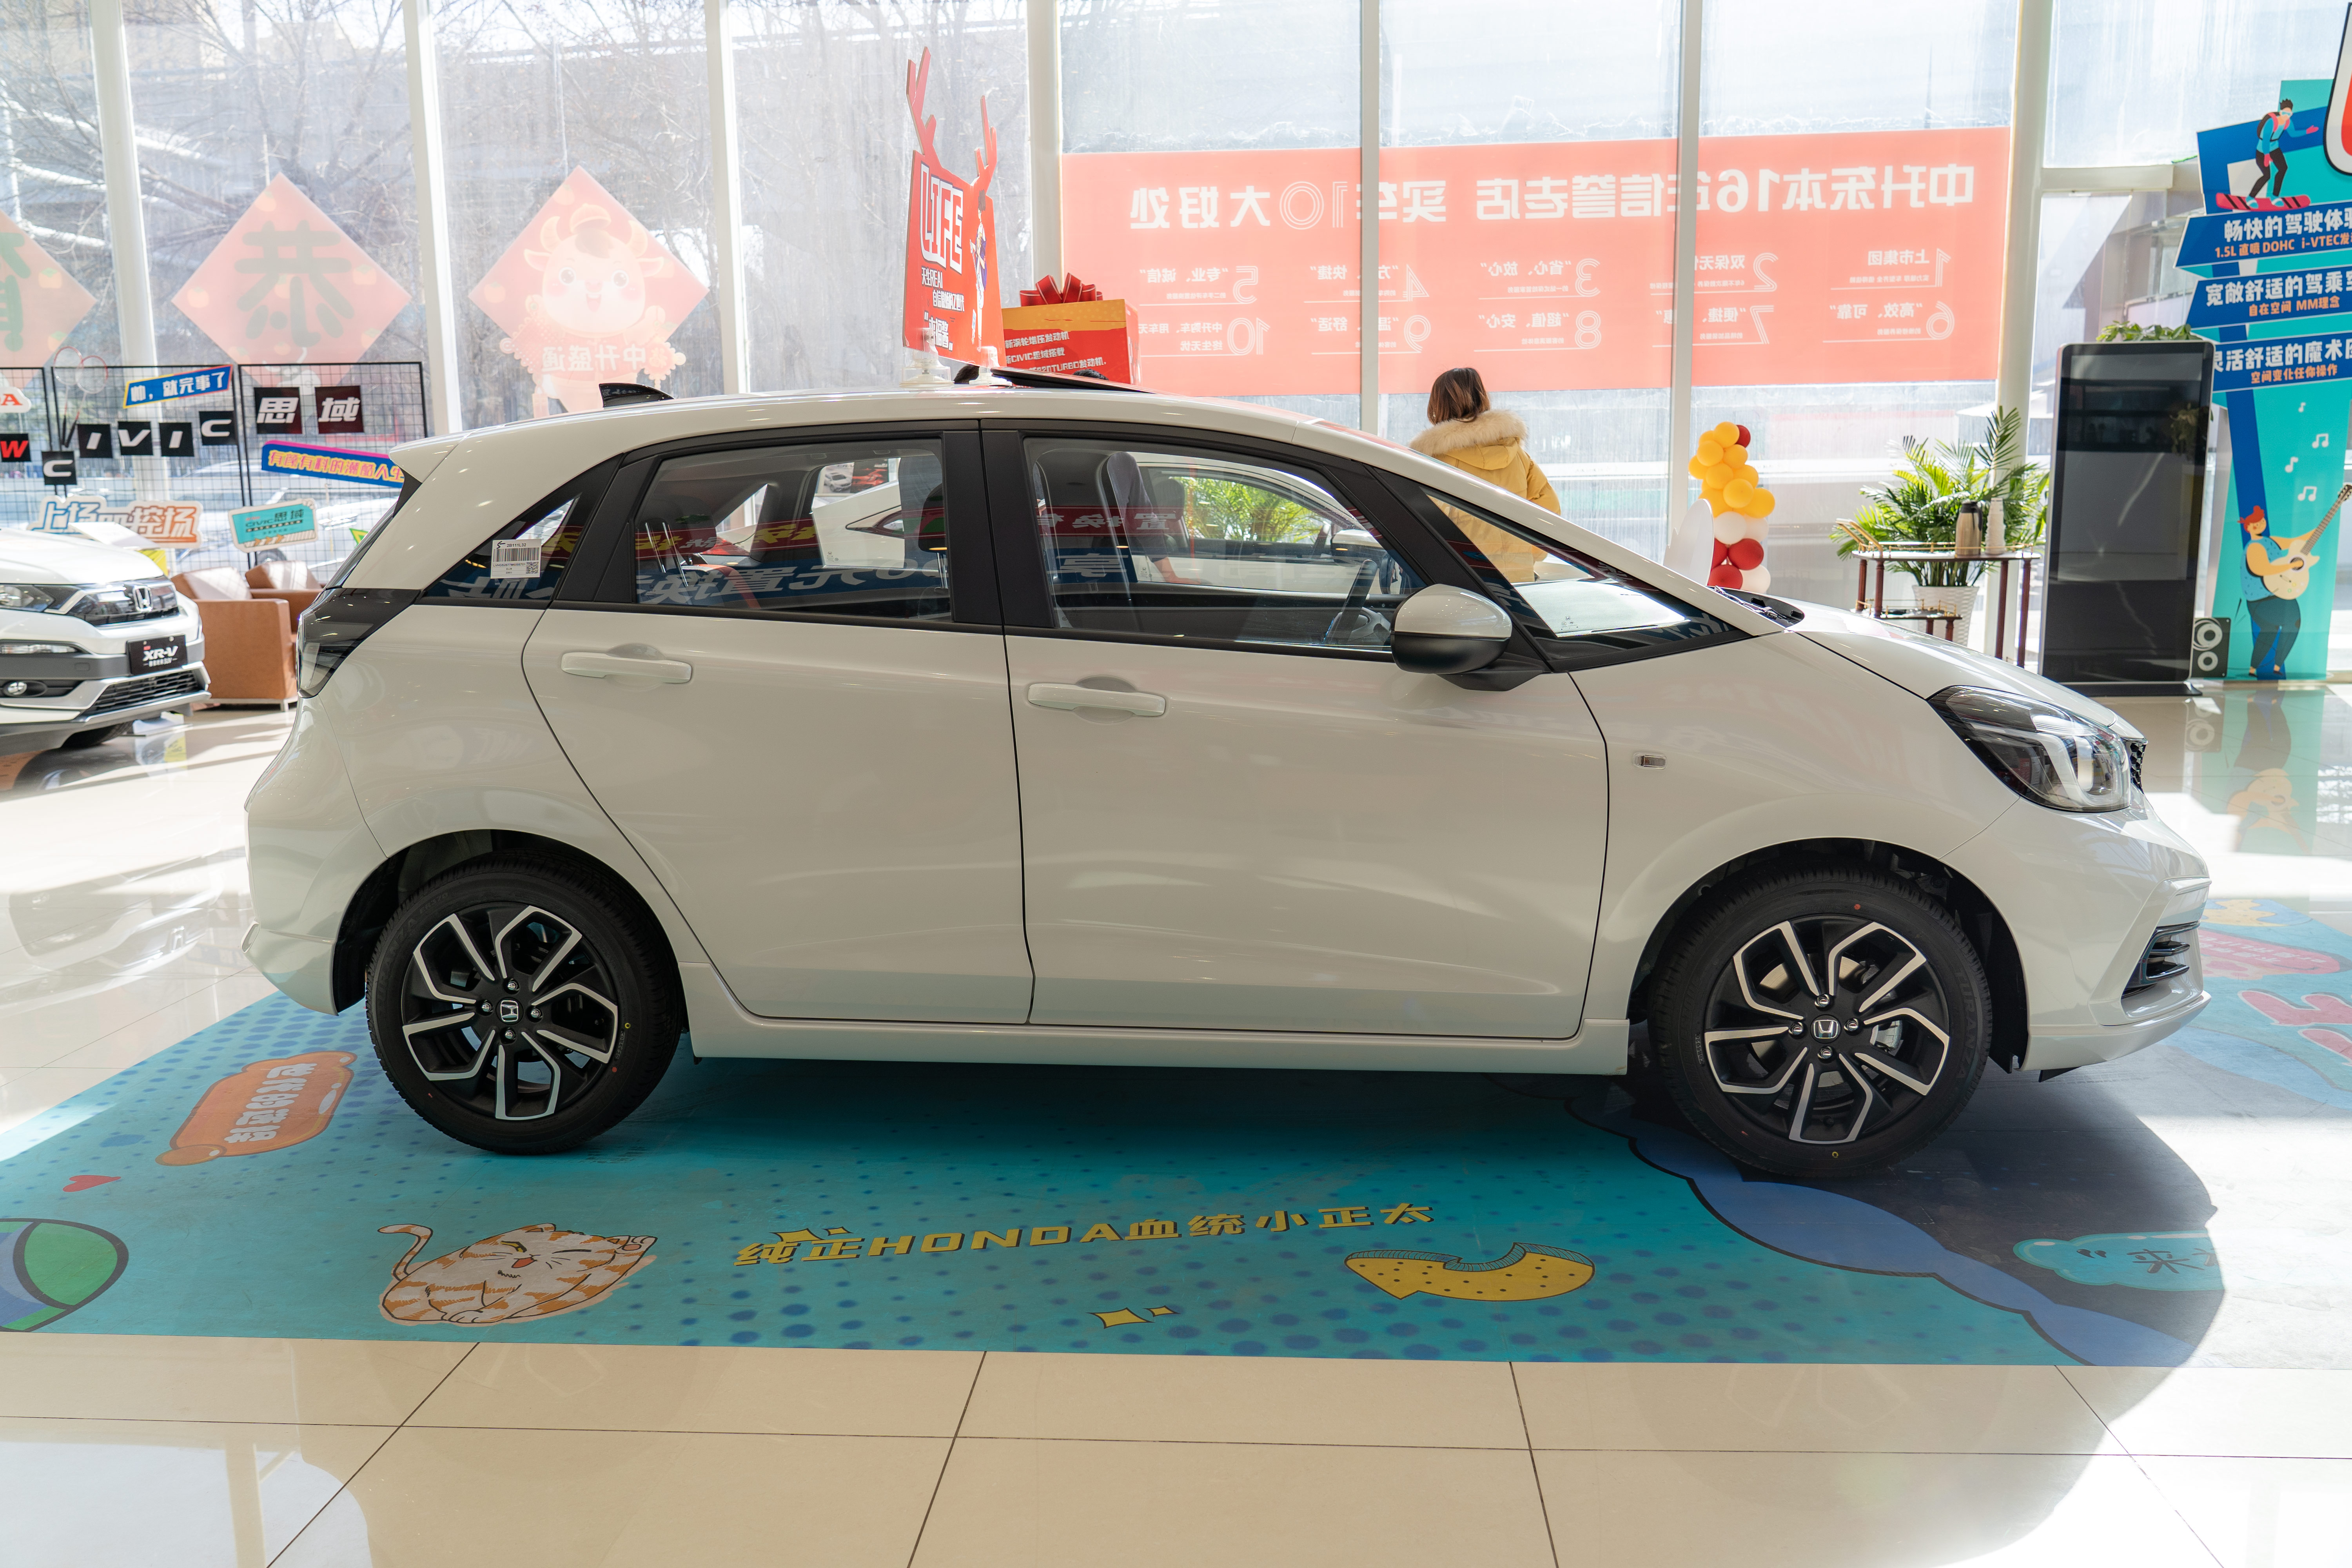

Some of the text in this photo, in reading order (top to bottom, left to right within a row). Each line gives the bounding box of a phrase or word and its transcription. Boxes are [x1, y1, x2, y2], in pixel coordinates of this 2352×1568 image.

[2215, 246, 2236, 258] 1.5L
[2263, 239, 2295, 253] DOHC
[2249, 296, 2340, 316] 自在空间 MM理念
[2251, 363, 2338, 384] 空间变化任你操作
[256, 396, 361, 424] 思域
[143, 646, 178, 661] XR-V
[733, 1202, 1435, 1267] 纯正HONDA血统小正太
